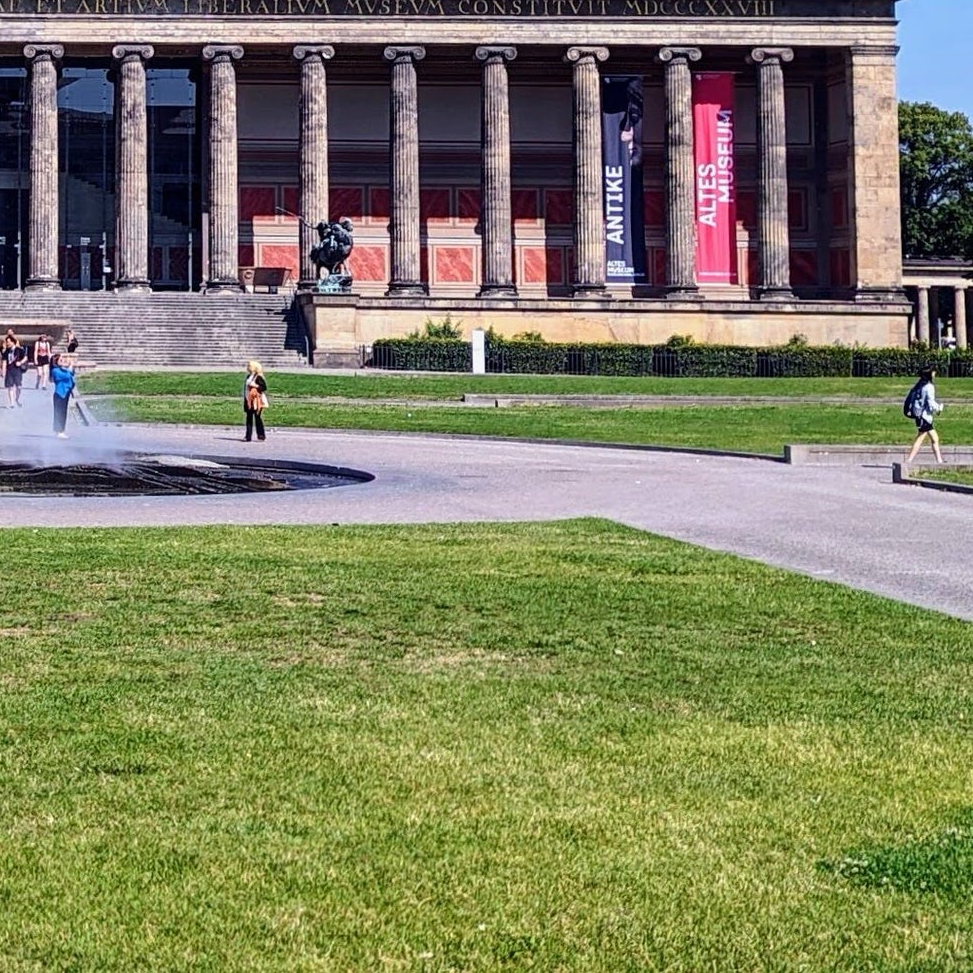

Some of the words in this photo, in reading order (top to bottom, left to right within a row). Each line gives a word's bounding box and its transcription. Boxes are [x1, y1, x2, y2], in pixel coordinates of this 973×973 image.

[458, 0, 611, 16] CONSTITVIT
[623, 0, 775, 16] MDCCCXXVIII
[716, 109, 734, 204] MUSEUM
[605, 165, 625, 245] ANTIKE
[697, 163, 717, 228] ALTES
